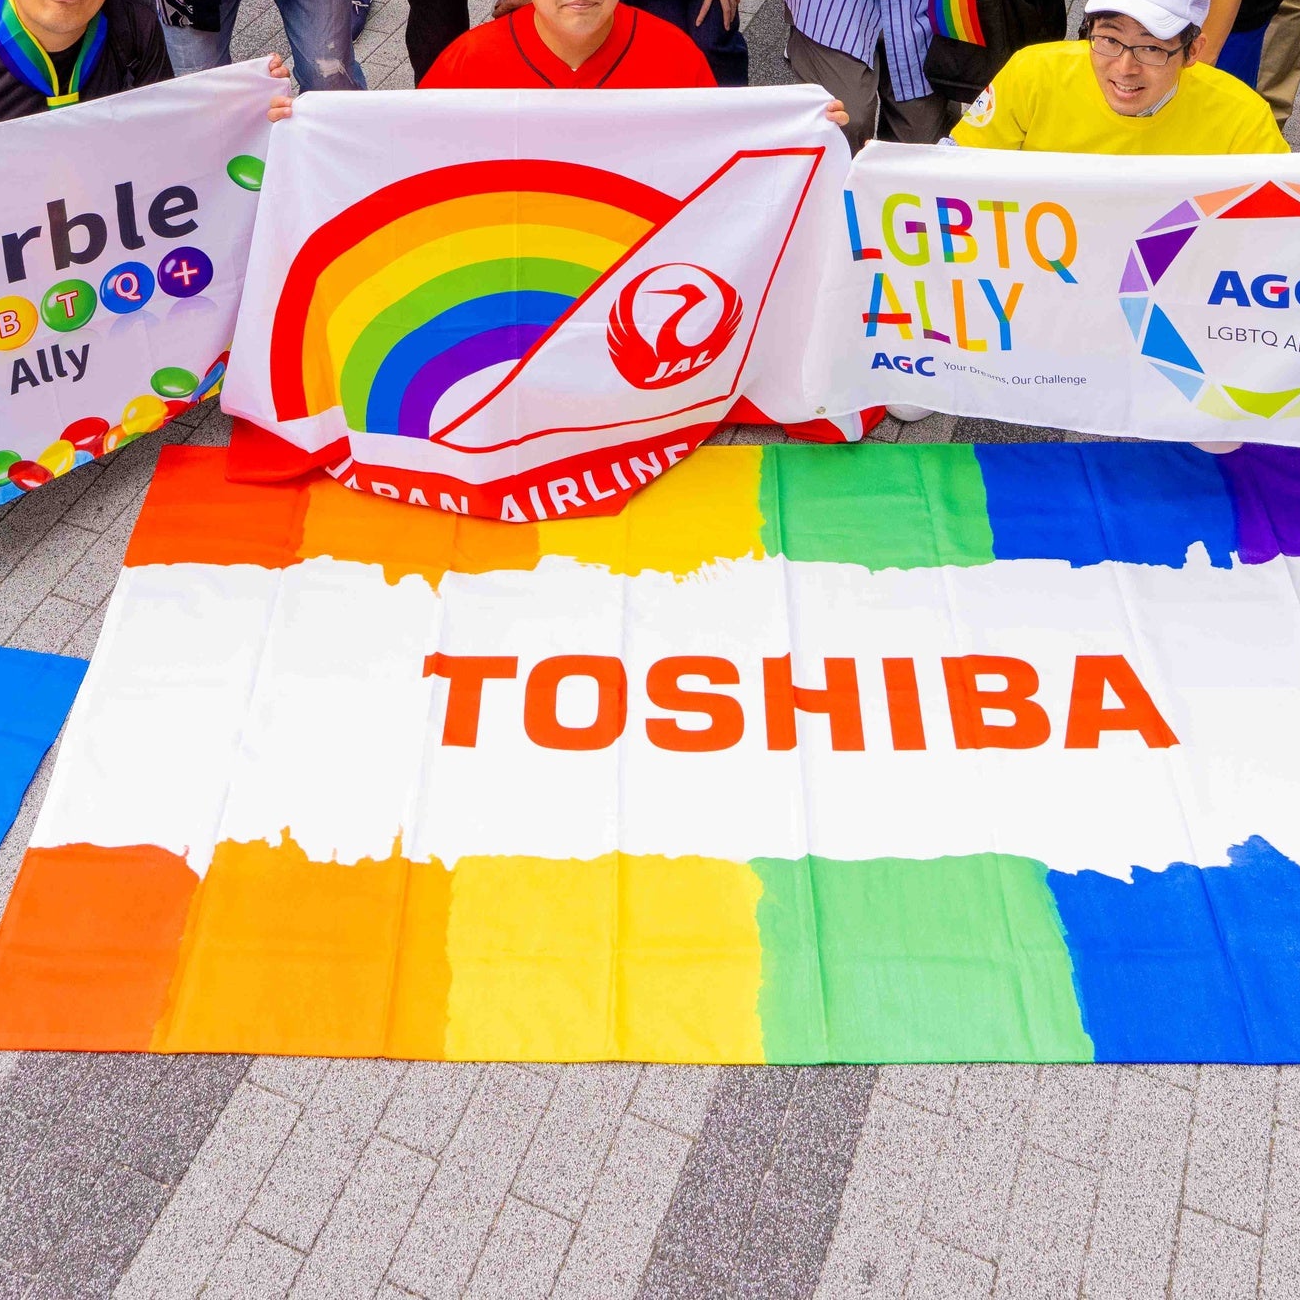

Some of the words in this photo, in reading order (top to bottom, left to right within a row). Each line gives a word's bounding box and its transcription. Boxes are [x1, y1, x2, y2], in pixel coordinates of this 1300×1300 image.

[843, 189, 1079, 284] LGBTQ
[861, 271, 1025, 353] ALLY
[1206, 324, 1280, 350] LGBTQ
[9, 343, 91, 396] Ally
[643, 349, 713, 383] JAL
[870, 351, 936, 378] AGC
[943, 361, 967, 372] Your
[1011, 375, 1032, 385] Our
[1034, 374, 1087, 386] Challenge
[499, 440, 706, 523] AIRLINE
[420, 653, 1181, 753] TOSHIBA
